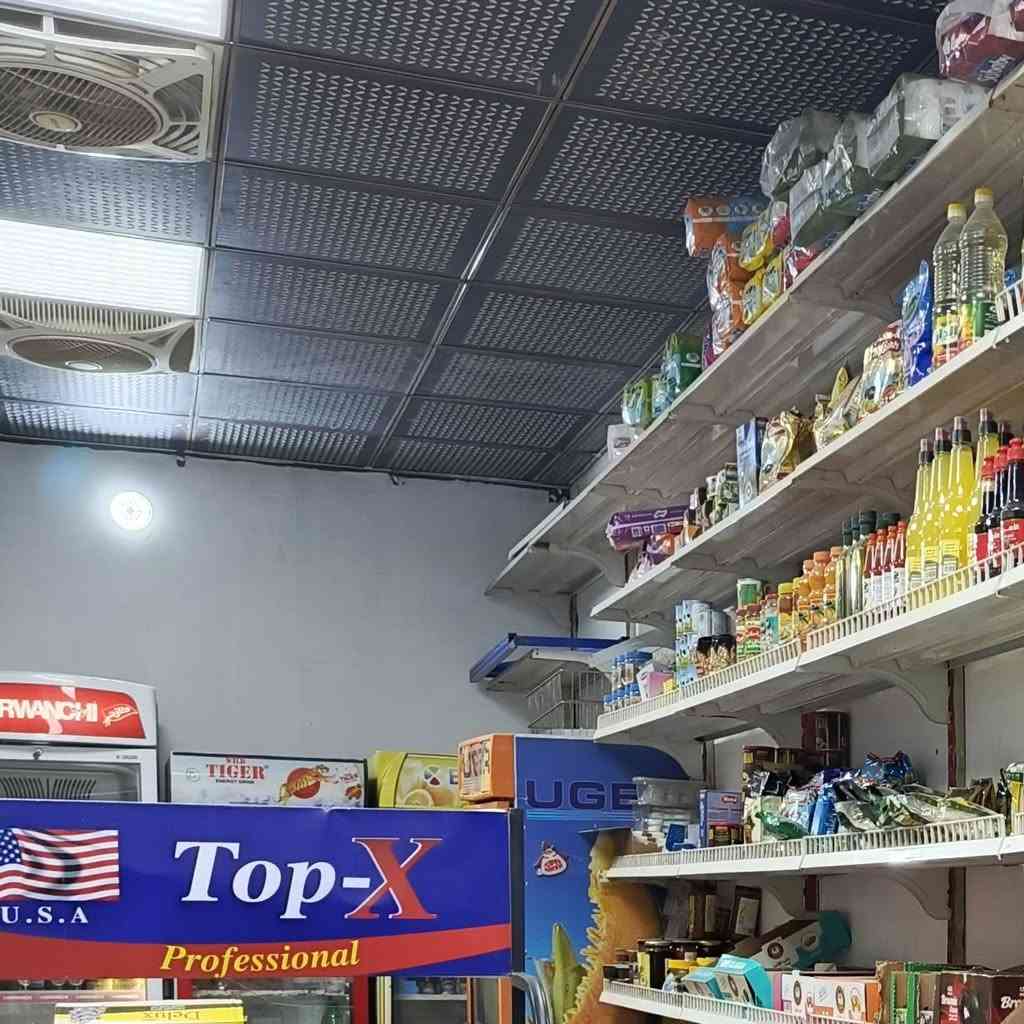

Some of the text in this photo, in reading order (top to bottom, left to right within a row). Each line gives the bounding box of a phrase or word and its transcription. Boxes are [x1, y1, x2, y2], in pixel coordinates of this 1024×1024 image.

[207, 763, 266, 779] TIGER
[174, 837, 444, 920] Top-X
[1, 905, 89, 925] U.S.A
[159, 939, 361, 979] Professional
